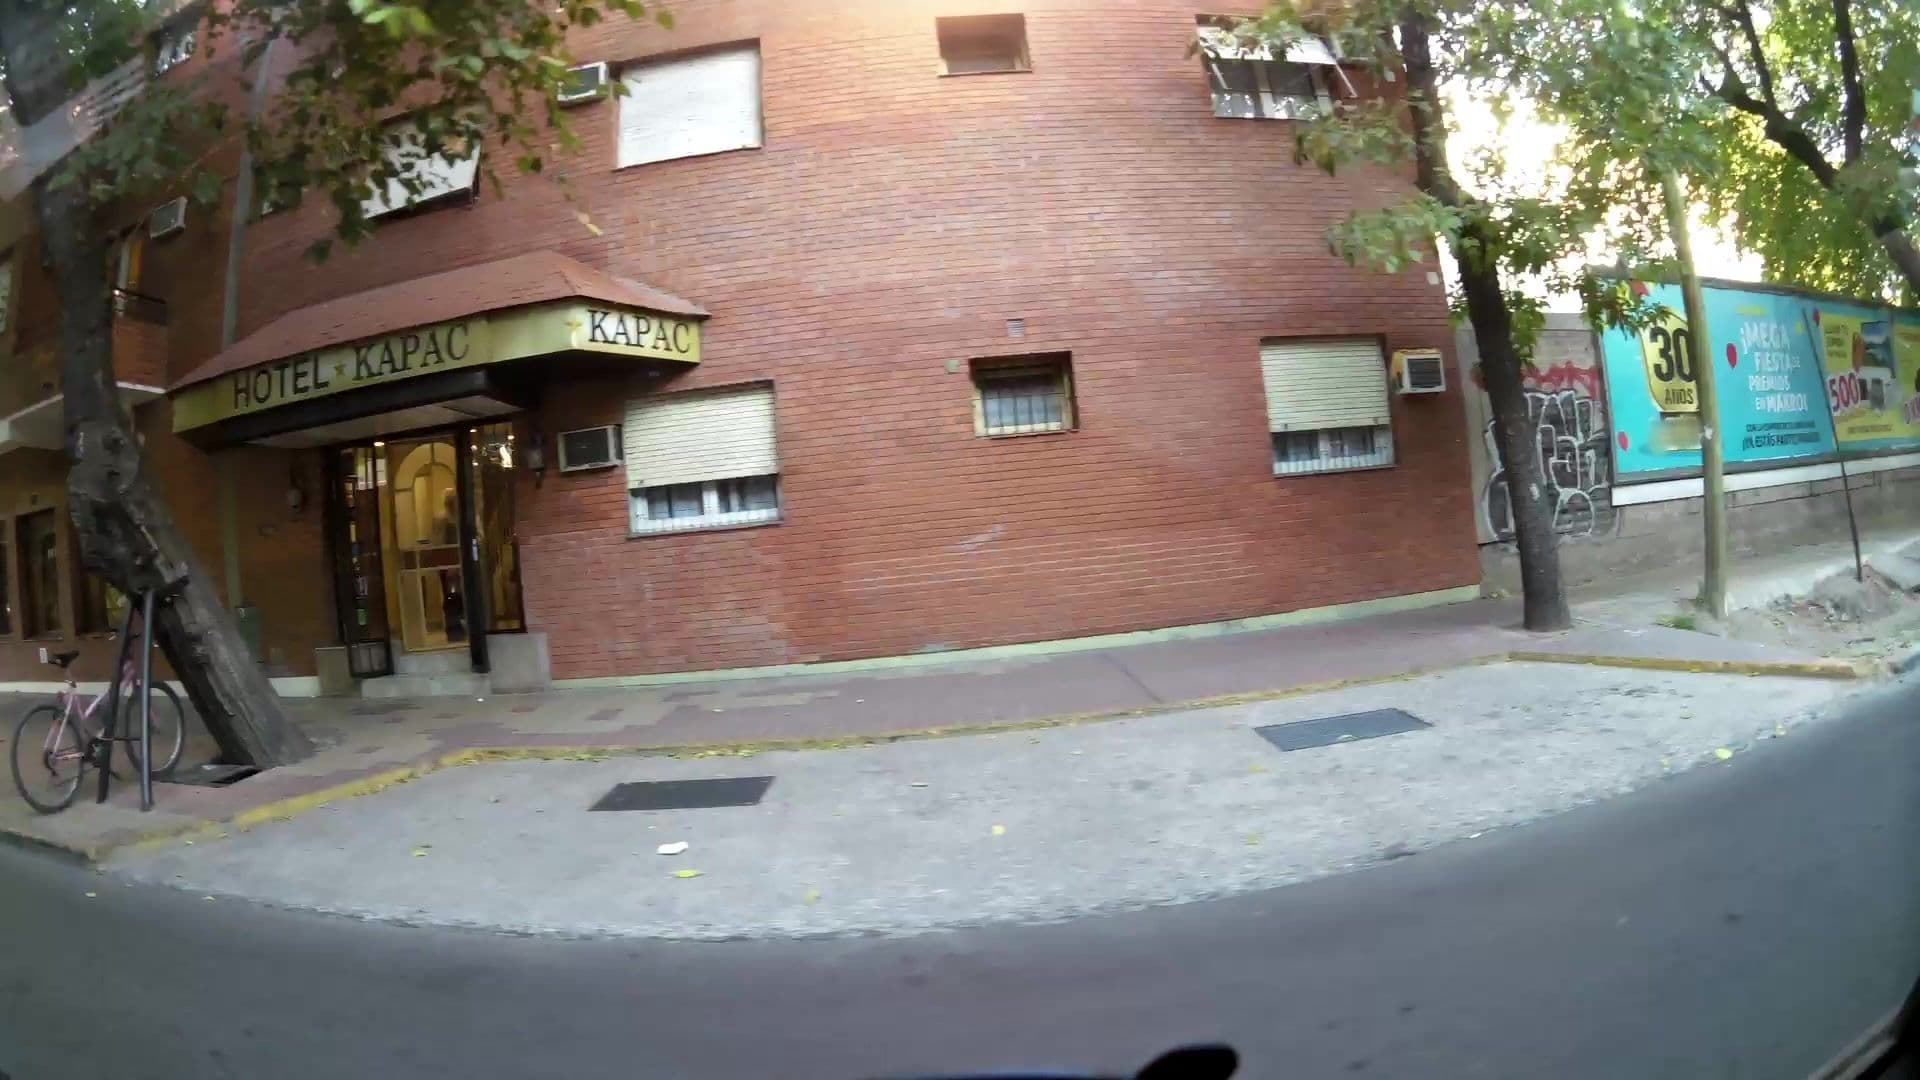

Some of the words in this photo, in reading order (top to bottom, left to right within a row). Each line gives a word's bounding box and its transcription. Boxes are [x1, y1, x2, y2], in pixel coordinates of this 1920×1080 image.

[588, 309, 690, 353] KAPAC
[1650, 327, 1696, 382] 30
[233, 354, 330, 409] HOTEL
[352, 325, 470, 380] KAPAC
